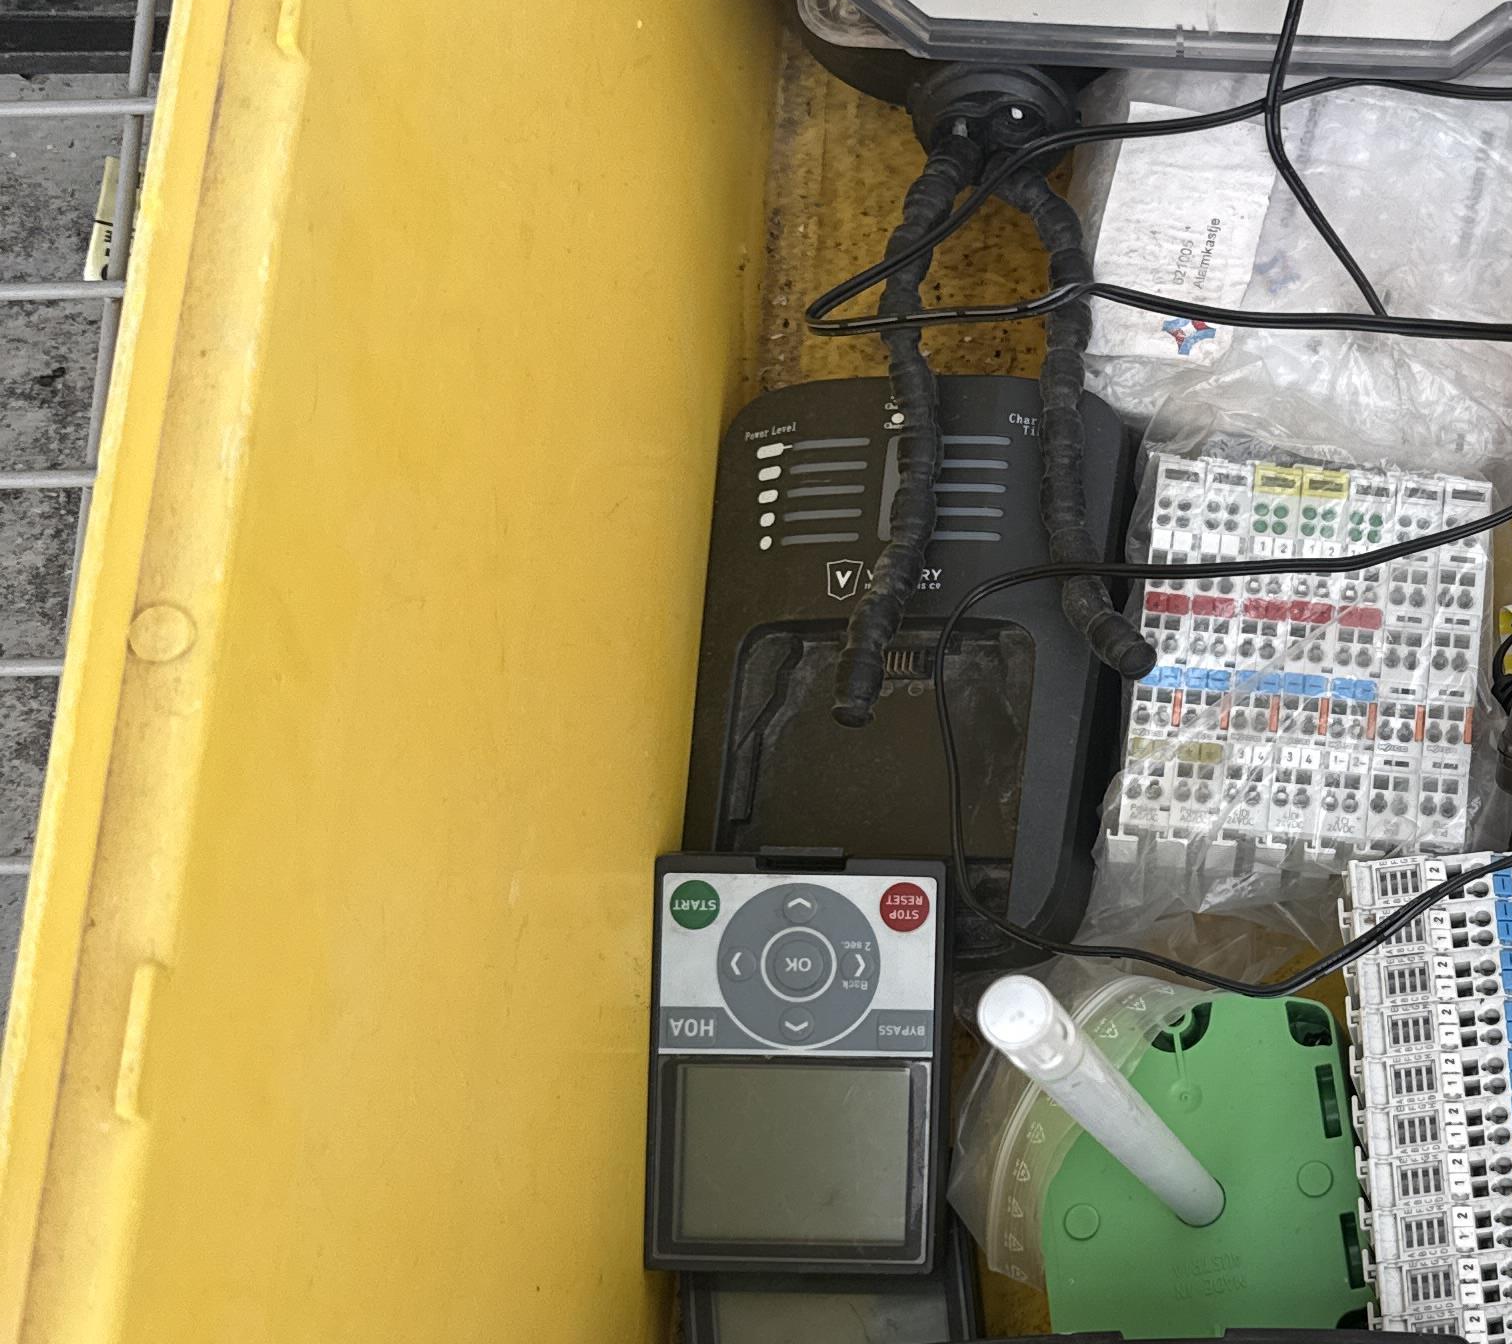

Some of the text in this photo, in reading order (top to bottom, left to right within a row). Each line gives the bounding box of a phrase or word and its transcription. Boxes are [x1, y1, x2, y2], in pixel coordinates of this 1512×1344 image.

[1009, 413, 1038, 425] Char
[745, 422, 796, 441] Power Level
[885, 894, 923, 905] RESET
[673, 899, 718, 912] START
[888, 908, 919, 919] STOP
[840, 940, 862, 949] sec.
[784, 956, 811, 971] OK
[841, 979, 867, 990] Back
[669, 1016, 716, 1038] HOA
[878, 1024, 924, 1035] BYPASS
